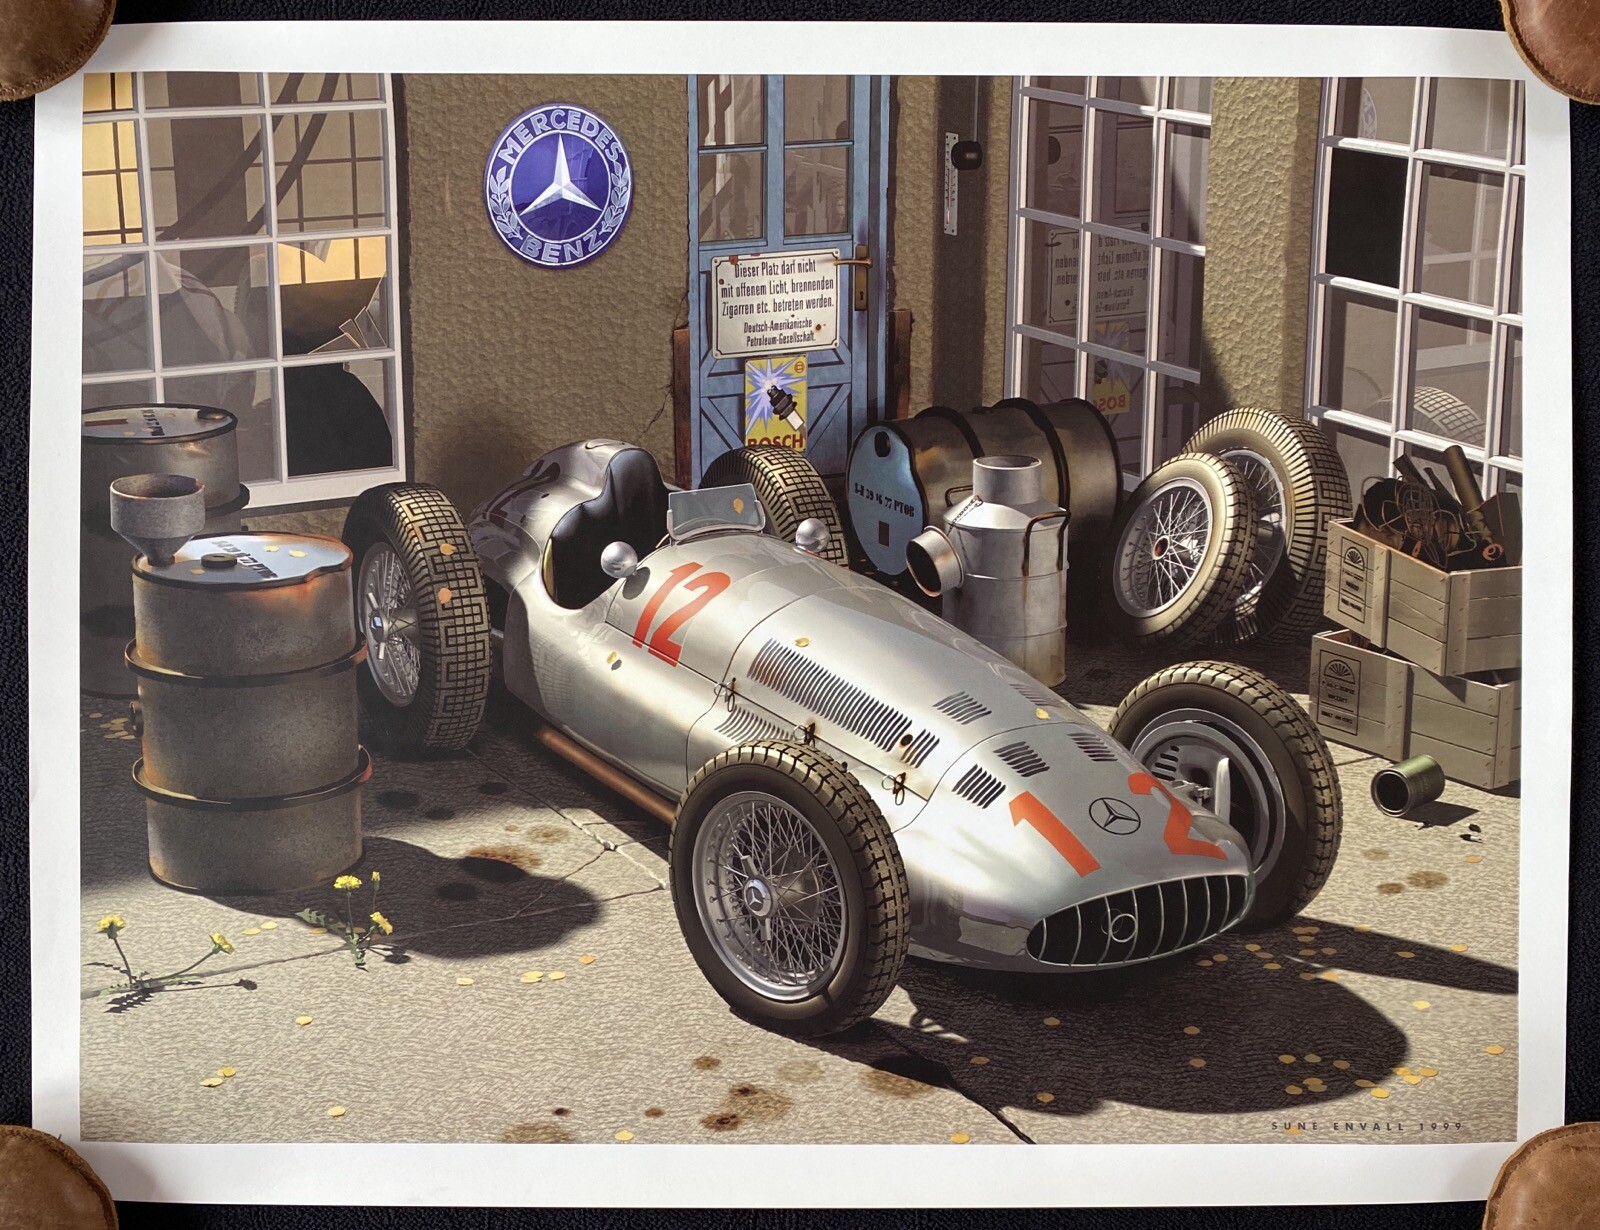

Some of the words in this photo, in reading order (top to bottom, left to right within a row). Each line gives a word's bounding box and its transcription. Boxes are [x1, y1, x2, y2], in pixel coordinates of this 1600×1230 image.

[497, 109, 625, 166] MERCEDES
[519, 229, 603, 264] BENZ
[735, 263, 759, 278] Dieser
[761, 261, 780, 276] Platz
[781, 259, 796, 275] darf
[797, 258, 816, 273] nicht
[721, 283, 734, 298] mit
[735, 282, 767, 297] offenem
[769, 279, 789, 295] Licht,
[791, 276, 834, 293] brennenden
[722, 301, 755, 319] Zigarren
[756, 300, 771, 314] etc.
[773, 298, 804, 312] betreten
[805, 294, 835, 310] werden.
[747, 433, 804, 448] BOSCH
[632, 561, 731, 668] 12
[1271, 1121, 1318, 1131] SUNE
[1333, 1122, 1405, 1131] ENVALL
[1419, 1122, 1463, 1131] 1999
